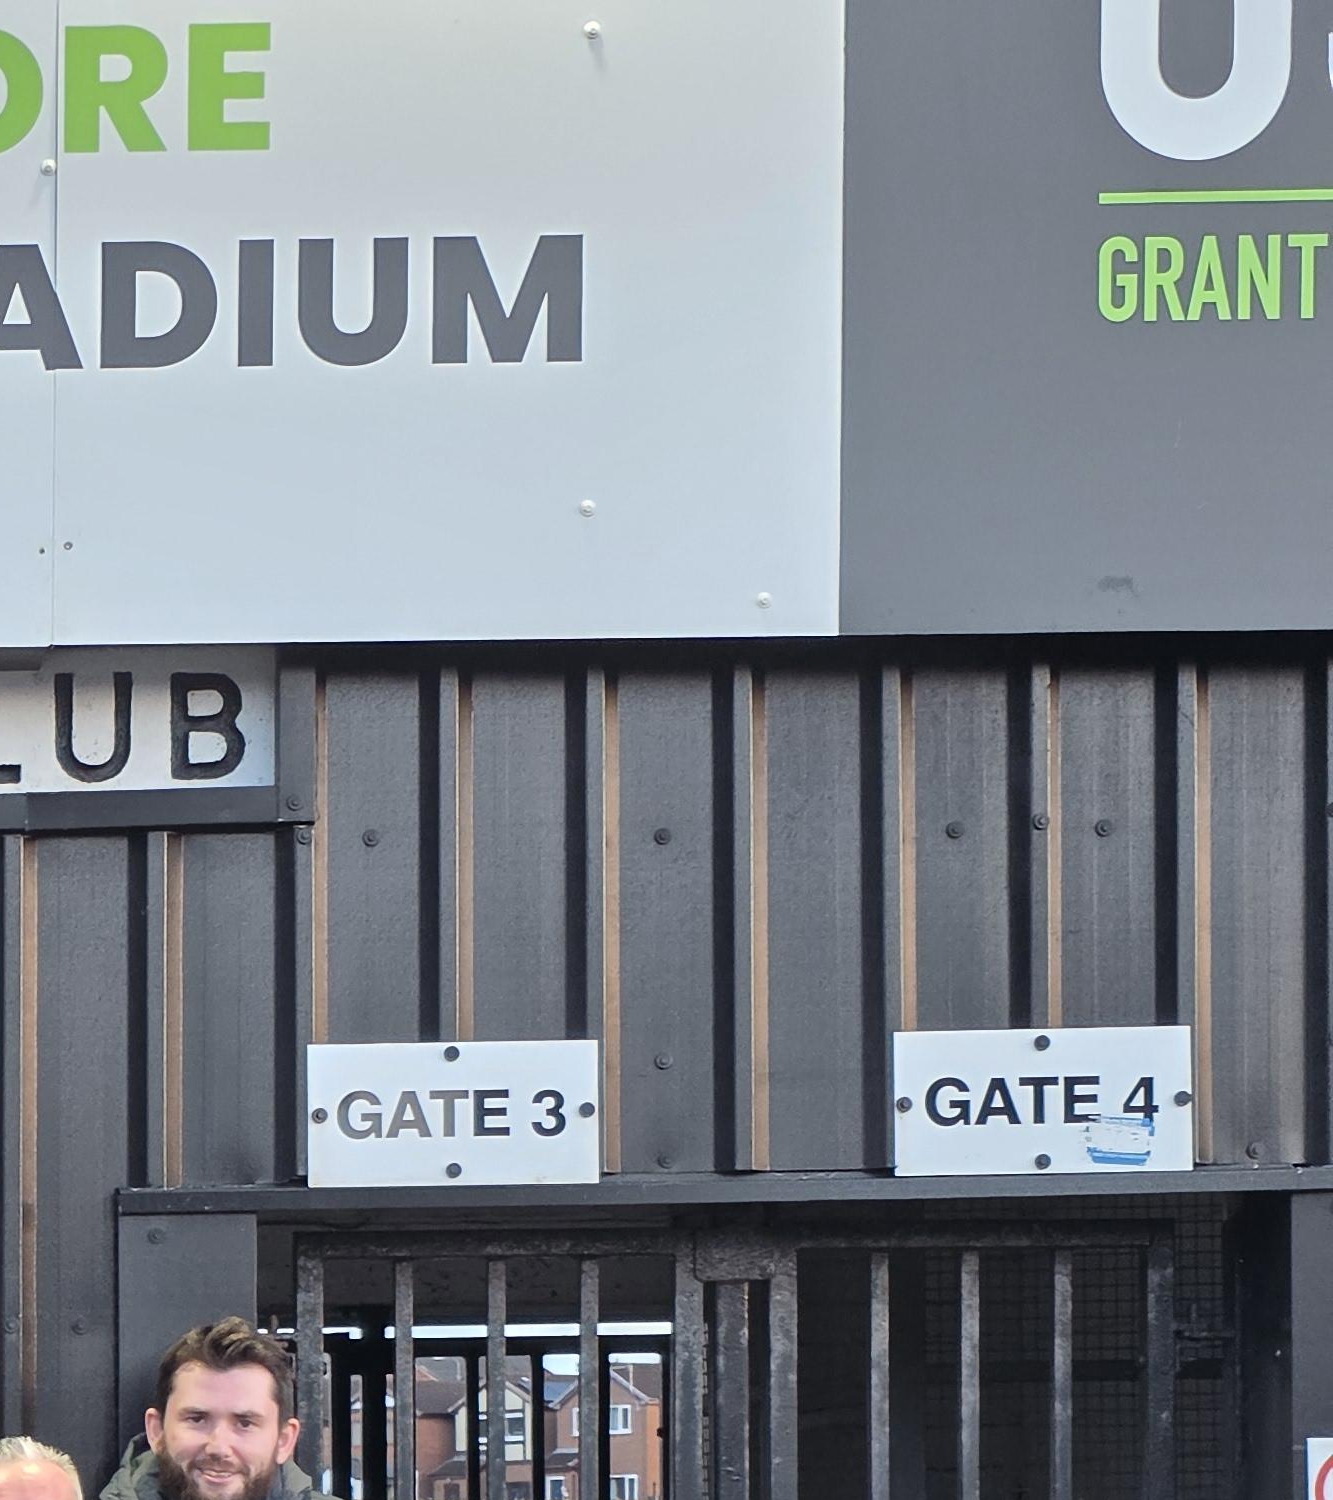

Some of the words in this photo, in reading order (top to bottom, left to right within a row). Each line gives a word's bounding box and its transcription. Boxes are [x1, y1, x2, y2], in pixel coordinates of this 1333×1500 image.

[1098, 233, 1328, 322] GRANT
[336, 1088, 510, 1139] GATE
[531, 1089, 567, 1137] 3
[924, 1075, 1101, 1126] GATE
[1122, 1076, 1159, 1122] 4
